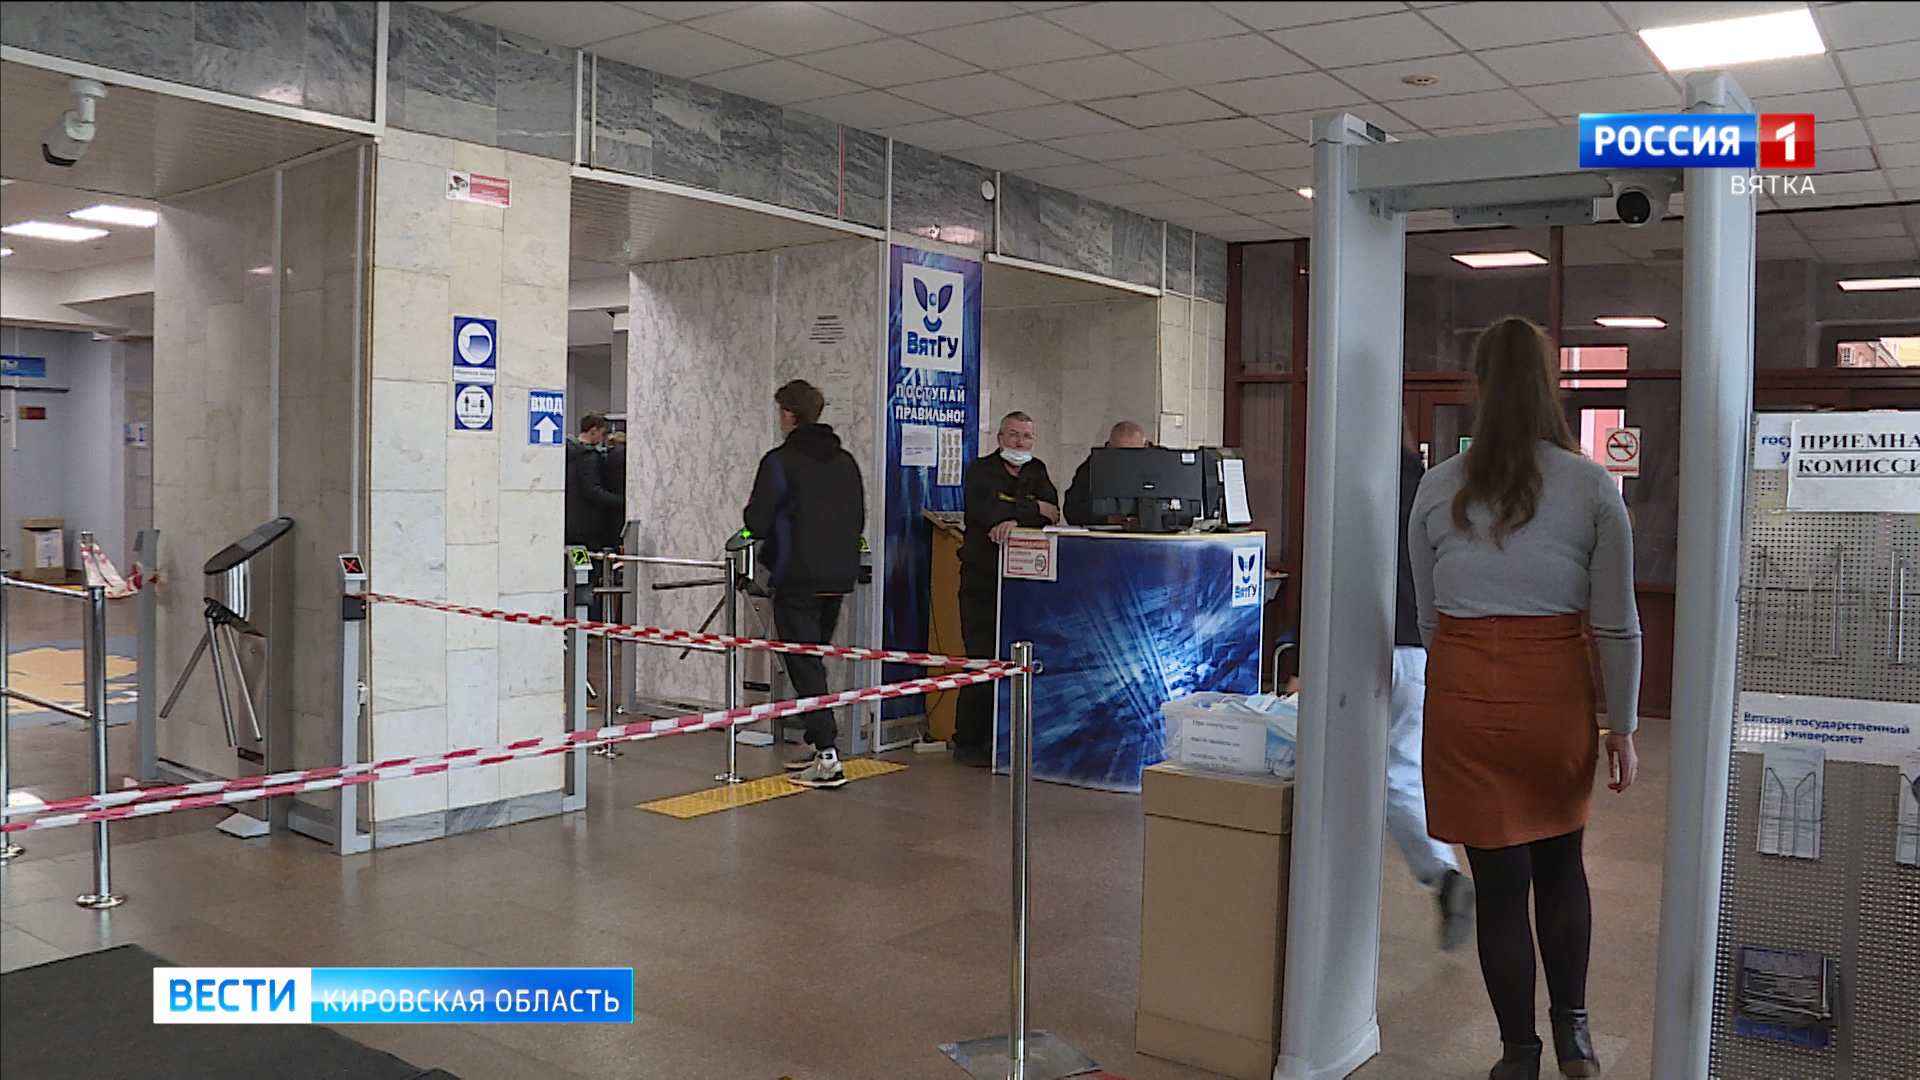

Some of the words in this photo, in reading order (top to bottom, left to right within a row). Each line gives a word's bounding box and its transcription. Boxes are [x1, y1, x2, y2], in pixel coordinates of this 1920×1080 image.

[907, 331, 959, 358] ВятГУ
[896, 383, 965, 402] ПОСТУПАЙ
[530, 396, 564, 415] ВХОД
[895, 405, 965, 424] ПРАВИЛЬНО!
[1800, 433, 1920, 449] ПРИЕМНА
[1798, 458, 1920, 474] КОМИССИ
[1743, 711, 1793, 725] Вятский
[1795, 718, 1910, 735] государственный
[1783, 731, 1865, 744] университет
